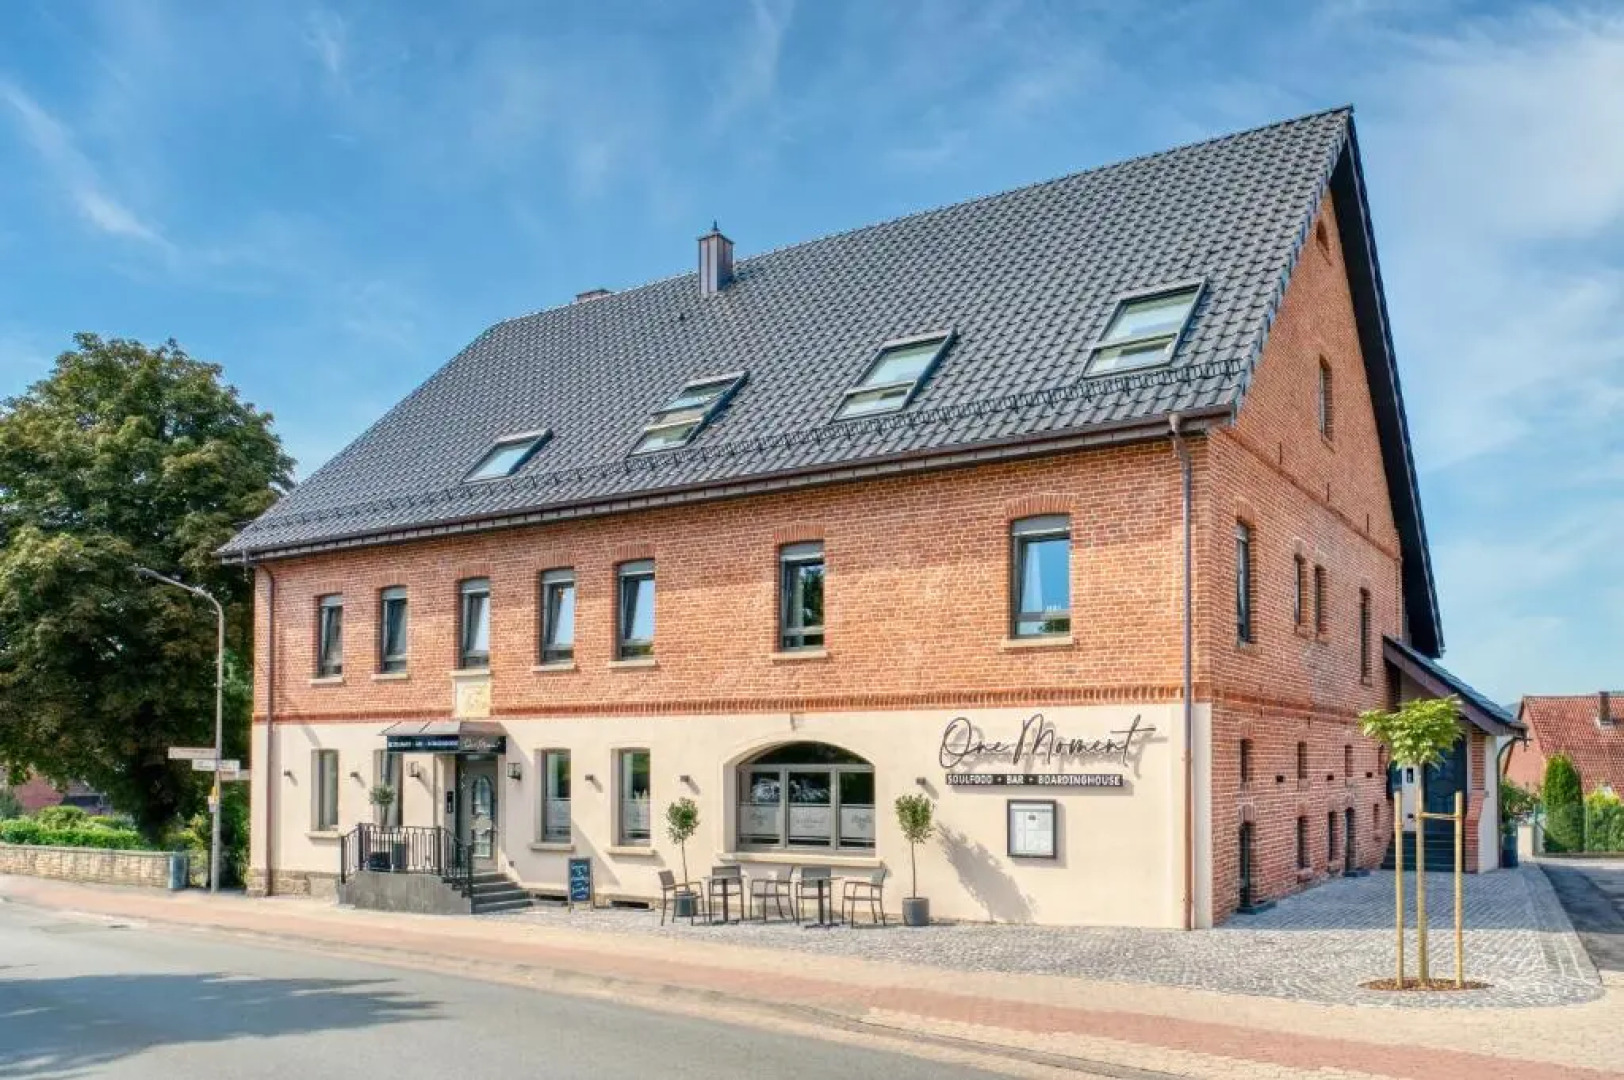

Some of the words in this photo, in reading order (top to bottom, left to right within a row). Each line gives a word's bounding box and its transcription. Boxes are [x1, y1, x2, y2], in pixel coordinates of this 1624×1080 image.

[939, 717, 1009, 768] One
[1013, 714, 1155, 767] Moment
[947, 775, 993, 784] SOULFOOD
[1006, 775, 1024, 784] BAR
[1038, 775, 1121, 786] BOARDINGHOUSE
